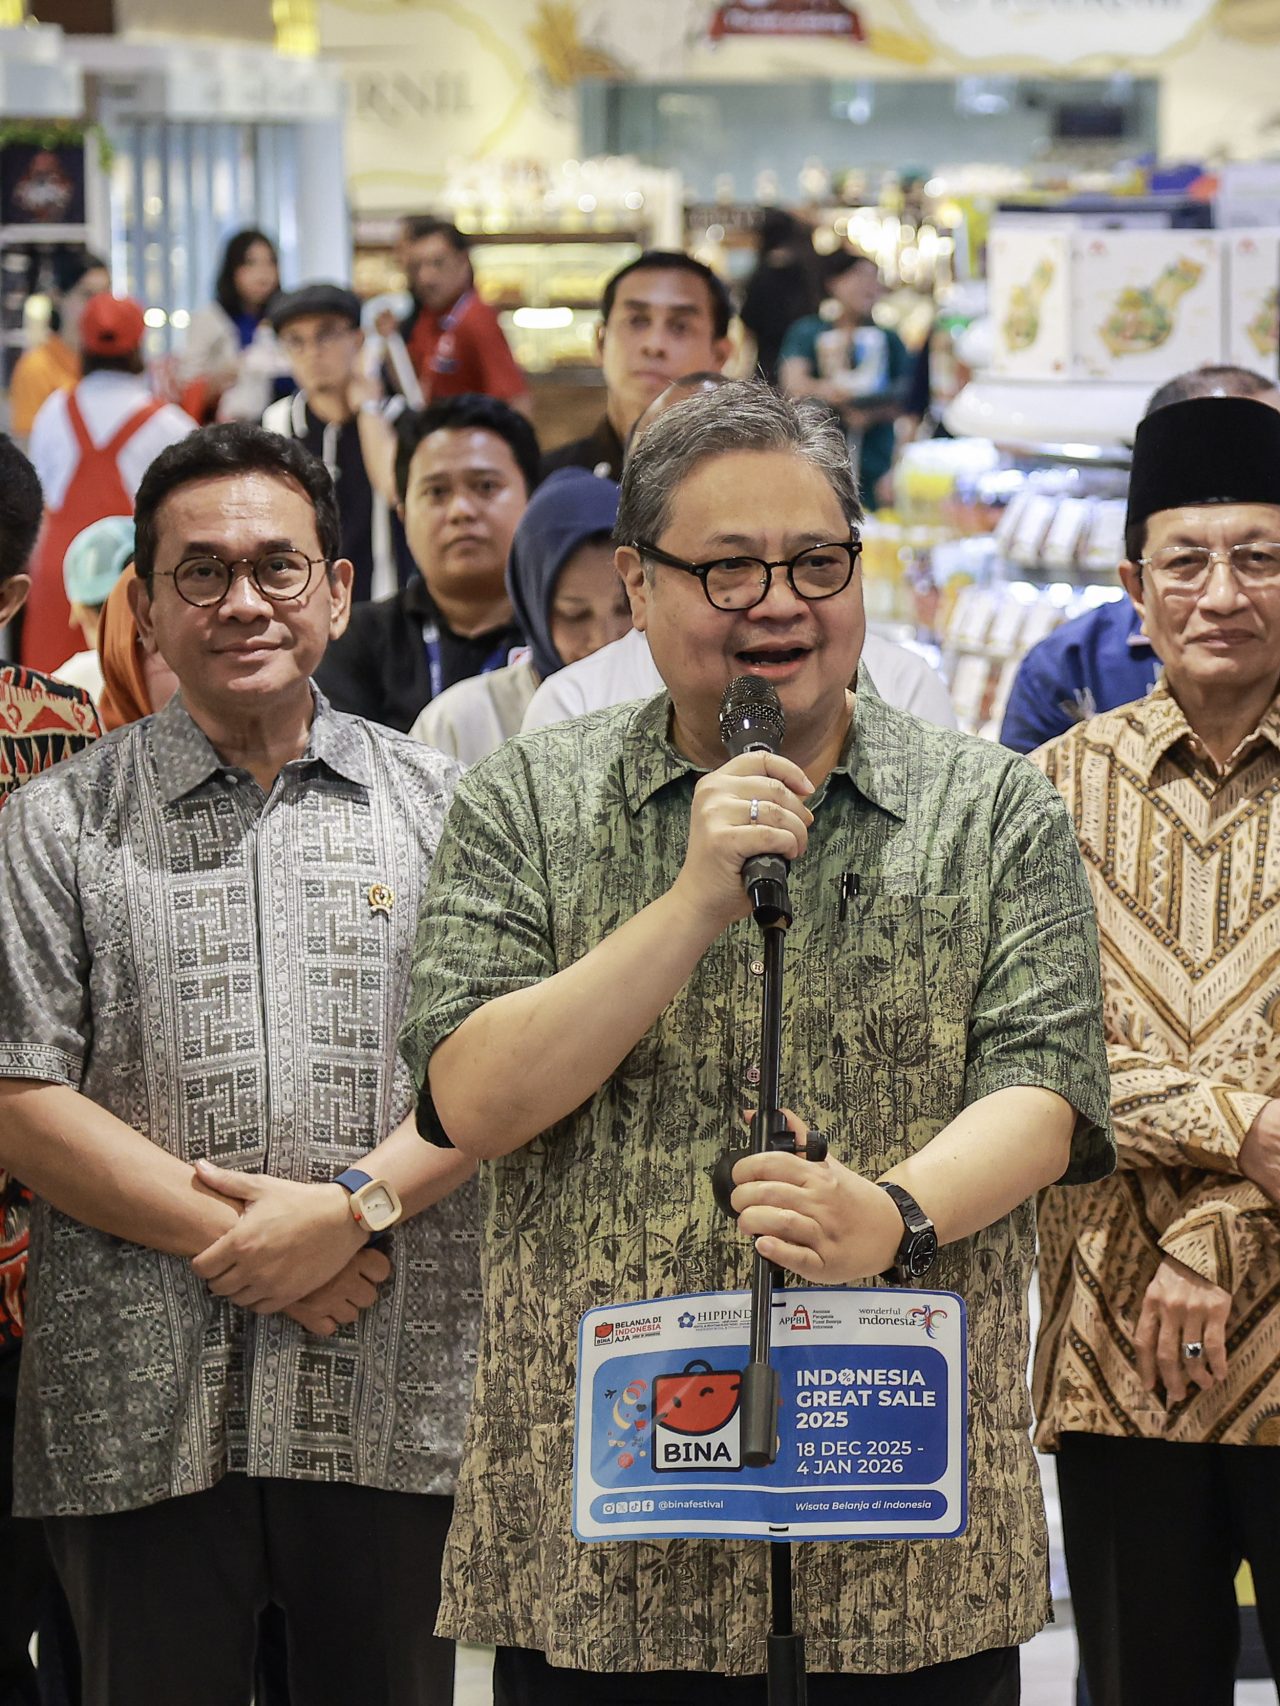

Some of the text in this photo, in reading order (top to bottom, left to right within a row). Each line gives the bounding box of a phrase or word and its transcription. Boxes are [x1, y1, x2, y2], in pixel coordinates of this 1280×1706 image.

[698, 1309, 753, 1323] HIPPIND
[859, 1307, 901, 1315] wonderful
[615, 1316, 662, 1330] BELANJA DI
[859, 1315, 916, 1326] indonesia
[615, 1324, 662, 1337] INDONESIA
[614, 1334, 631, 1343] AJA
[796, 1390, 936, 1408] GREAT SALE
[796, 1411, 849, 1429] 2025
[664, 1441, 732, 1462] BINA
[796, 1442, 815, 1457] 18
[821, 1441, 862, 1456] DEC
[866, 1440, 912, 1455] 2025
[796, 1459, 904, 1475] 4 JAN 2026
[658, 1500, 724, 1510] @binafestival
[795, 1500, 932, 1511] Wisata Belanja di Indonesia
